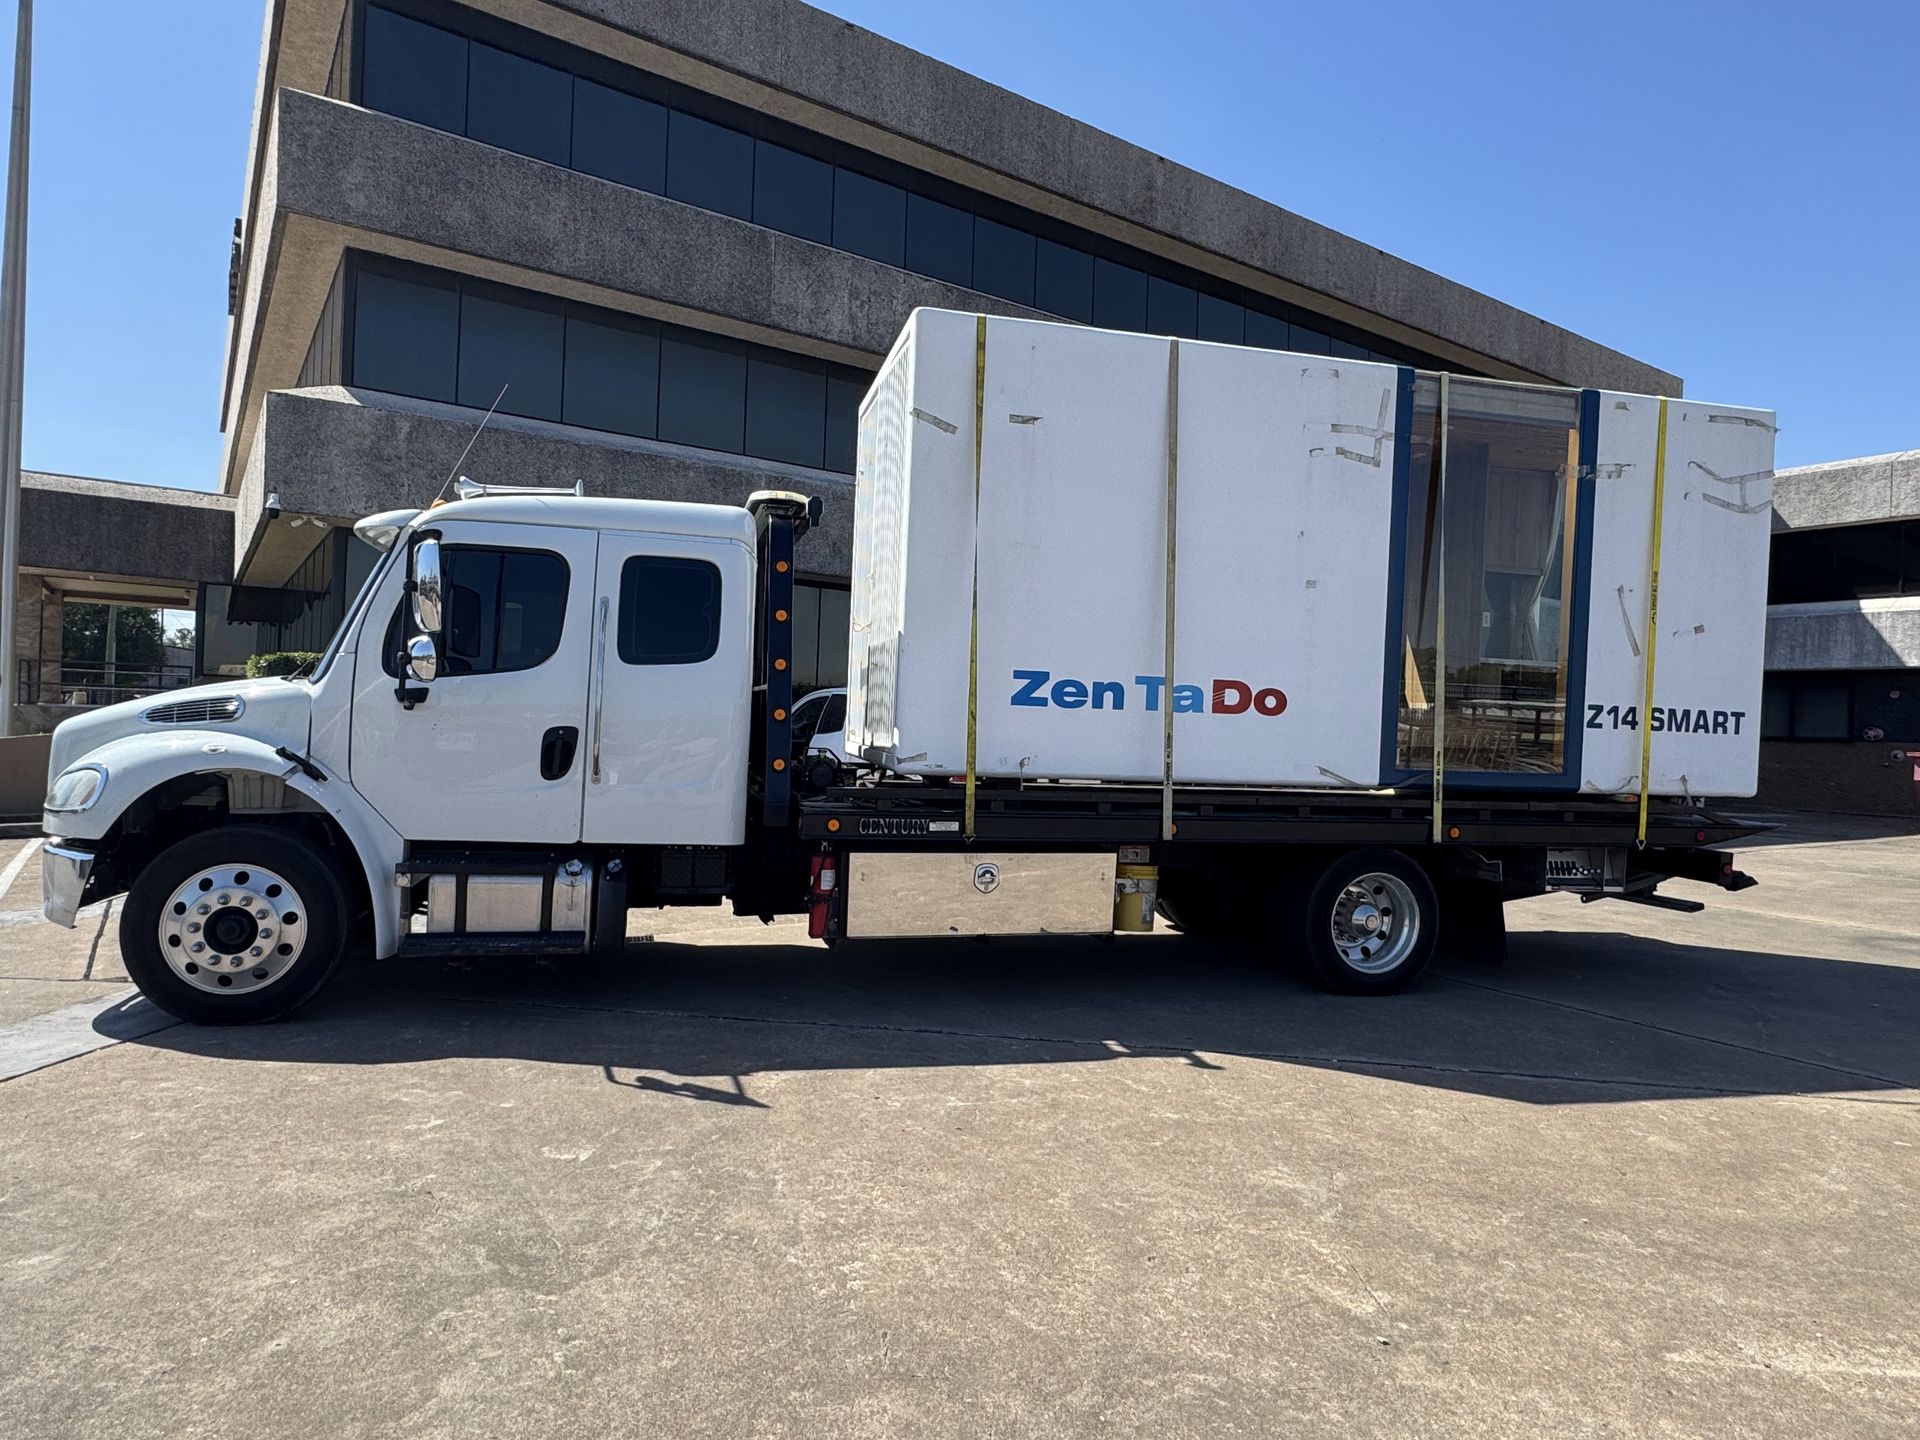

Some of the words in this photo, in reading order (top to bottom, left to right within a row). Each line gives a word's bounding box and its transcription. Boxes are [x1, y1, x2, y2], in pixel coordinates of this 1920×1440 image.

[1586, 704, 1639, 731] Z14
[1650, 707, 1746, 735] SMART
[859, 818, 930, 835] CENTURY
